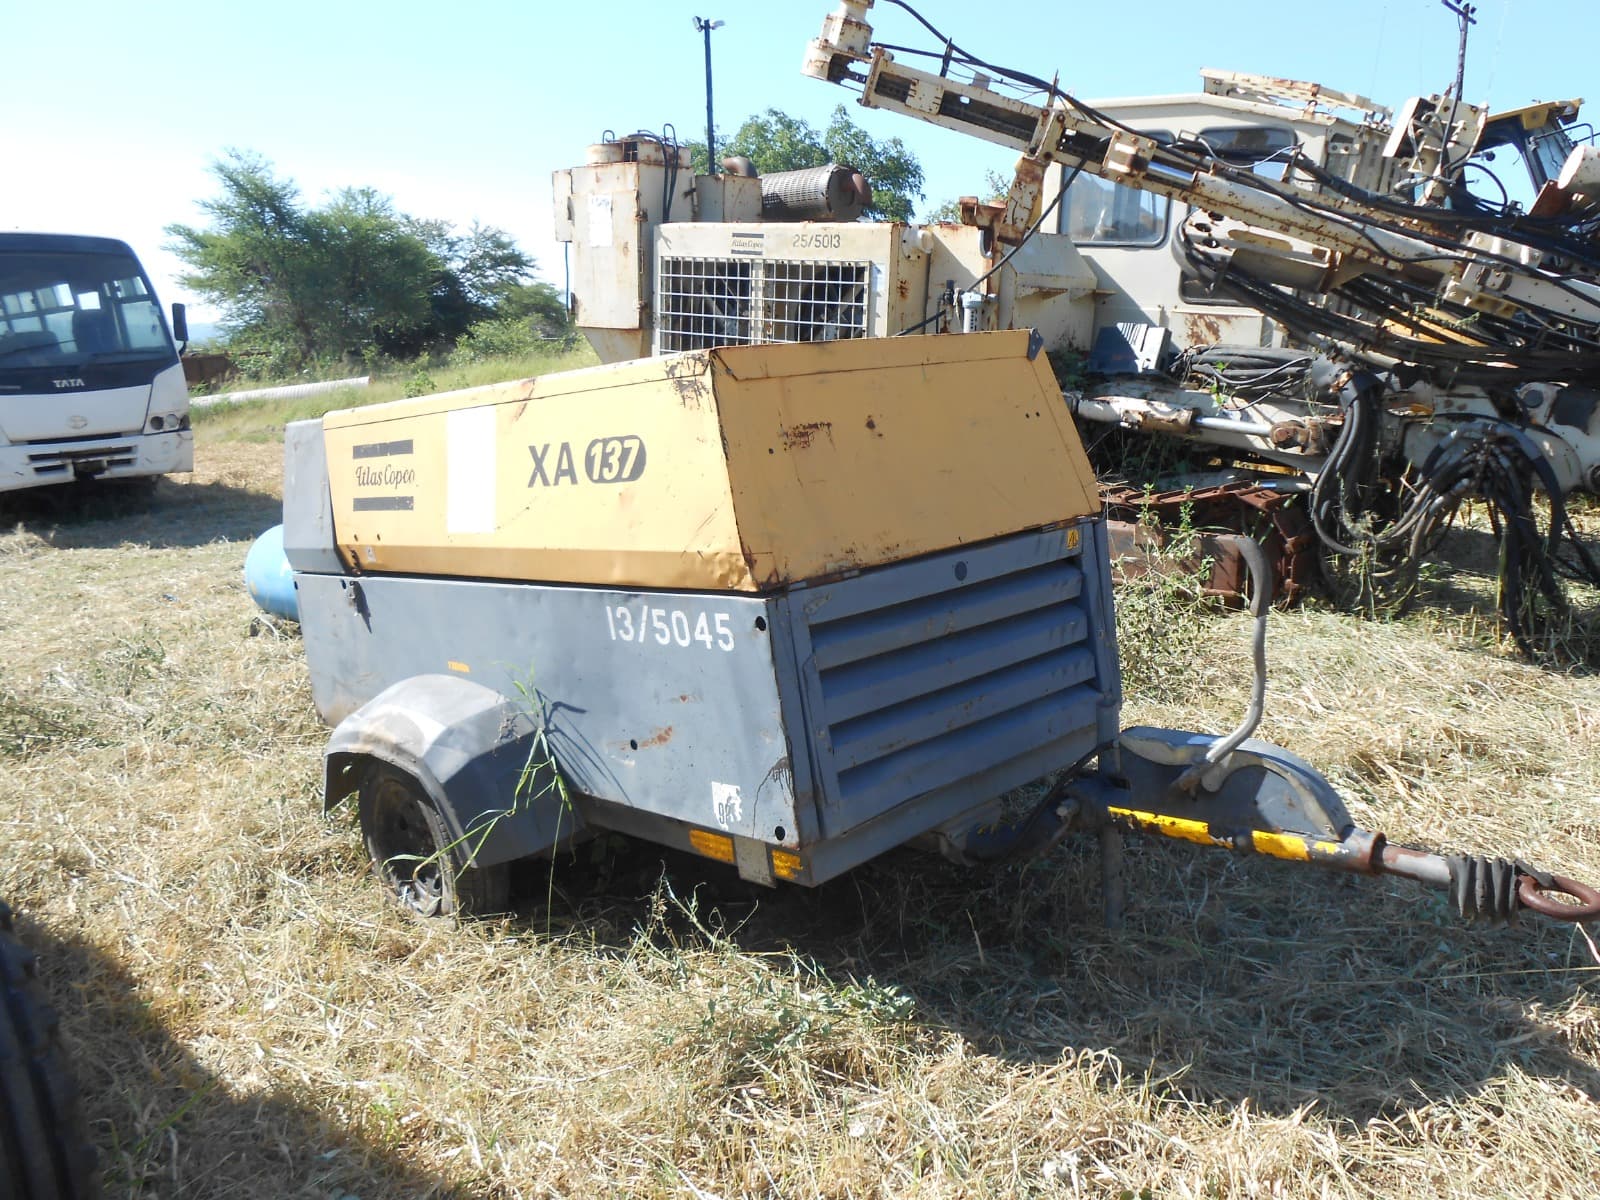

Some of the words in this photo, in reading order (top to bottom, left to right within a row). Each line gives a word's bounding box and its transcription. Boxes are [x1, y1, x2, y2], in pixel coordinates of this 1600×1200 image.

[793, 234, 841, 248] 25/5013
[52, 378, 85, 388] TATA
[384, 463, 415, 490] Copco
[528, 442, 578, 488] XA
[589, 438, 641, 482] 137
[606, 605, 735, 651] 13/5045
